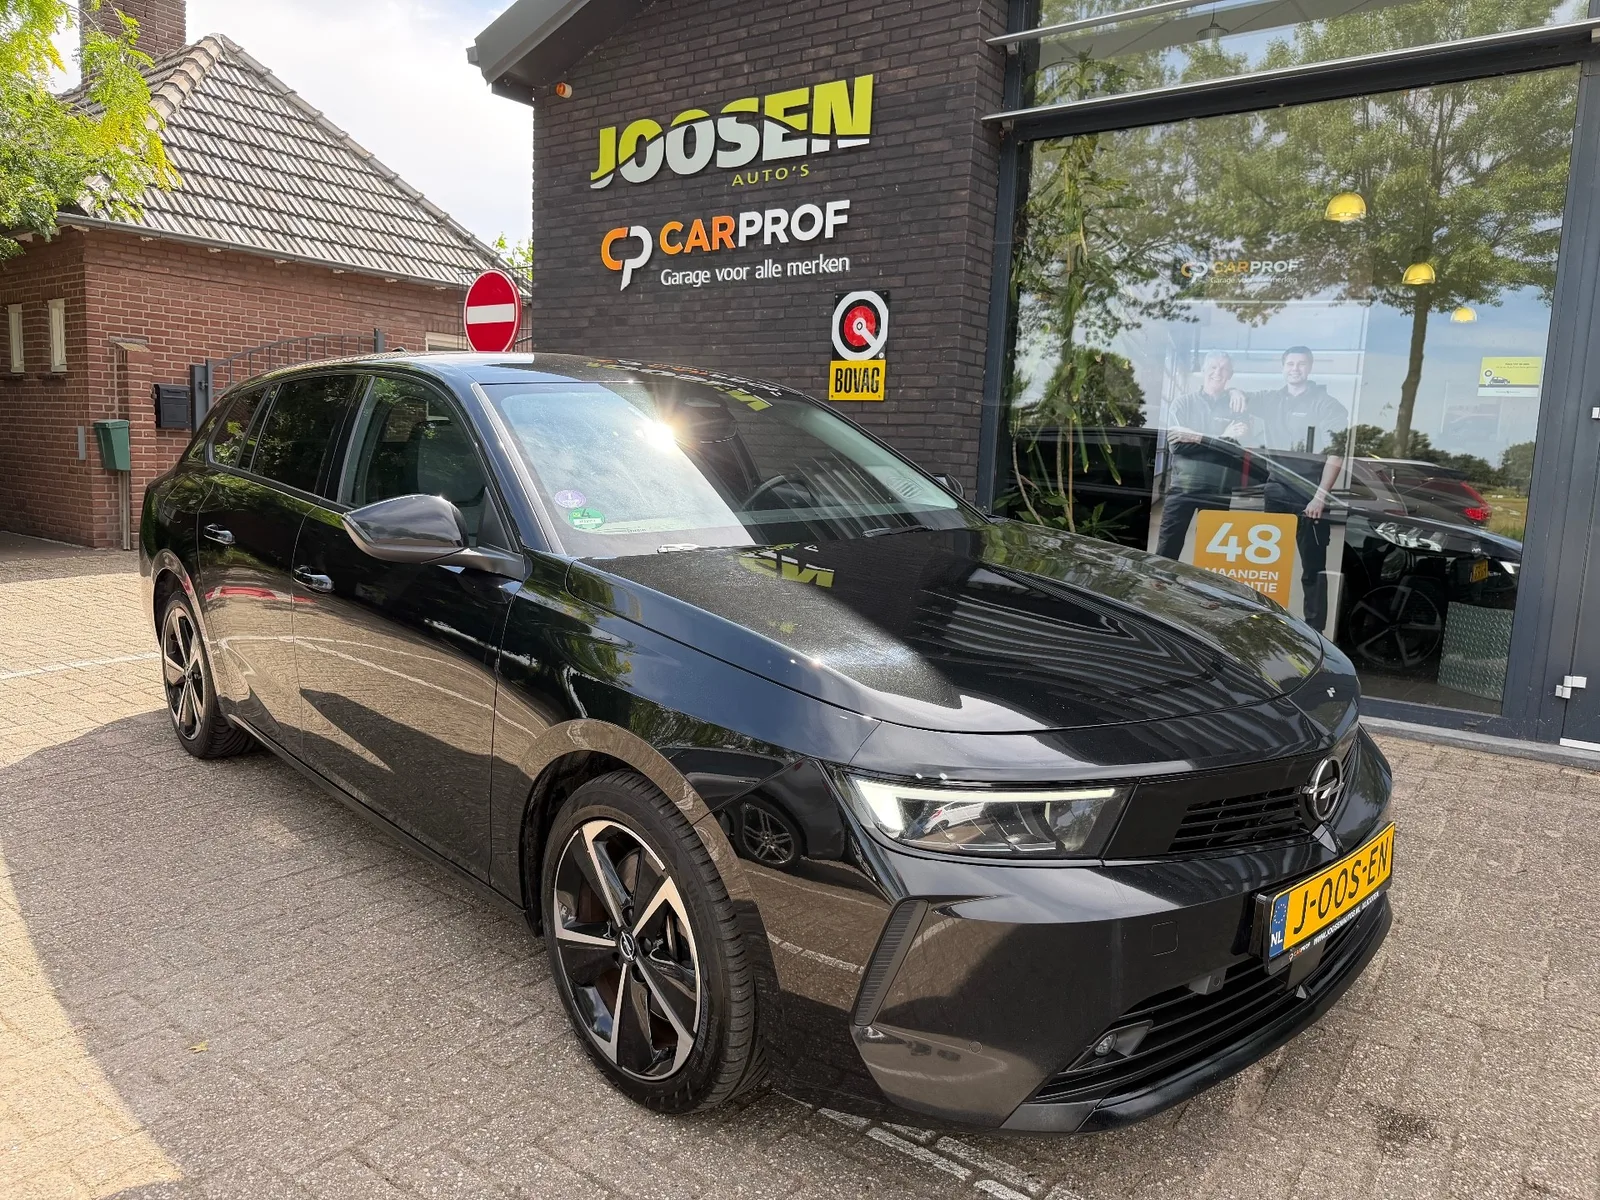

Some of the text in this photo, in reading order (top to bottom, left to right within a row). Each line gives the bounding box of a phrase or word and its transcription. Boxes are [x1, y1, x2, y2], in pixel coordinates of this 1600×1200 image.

[590, 74, 873, 189] JOOSEN
[731, 164, 810, 187] AUTO'S
[659, 199, 850, 255] CARPROF
[660, 253, 849, 287] Garage voor alle merken
[1212, 260, 1299, 274] CARPROF
[834, 366, 880, 394] BOVAG
[1205, 522, 1282, 565] 48
[1270, 930, 1284, 948] NL
